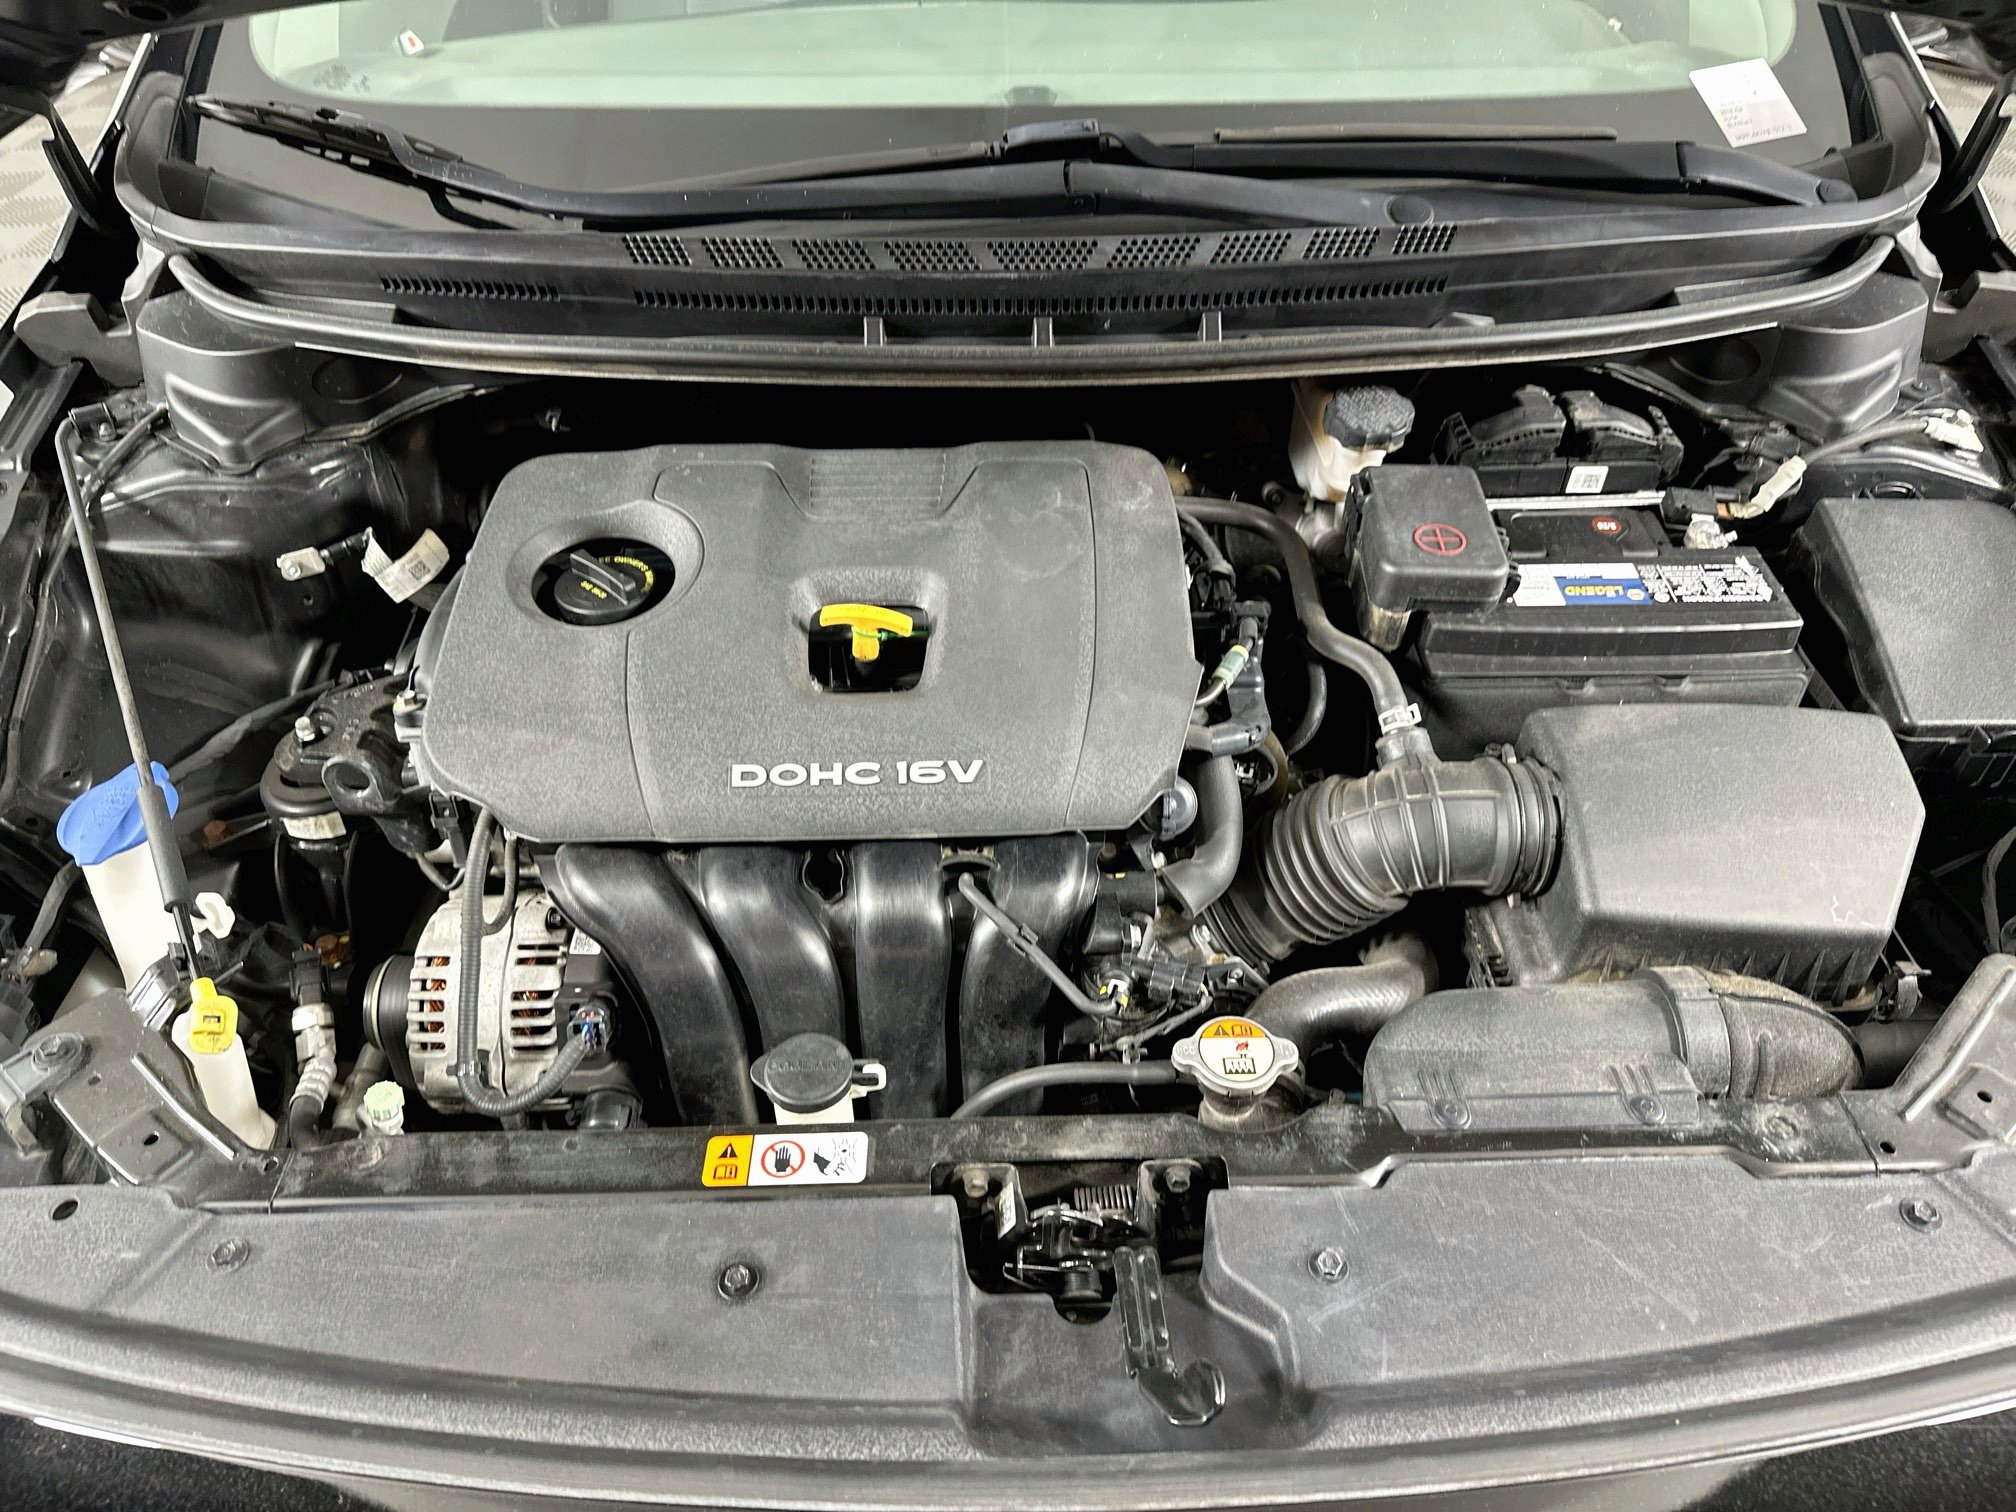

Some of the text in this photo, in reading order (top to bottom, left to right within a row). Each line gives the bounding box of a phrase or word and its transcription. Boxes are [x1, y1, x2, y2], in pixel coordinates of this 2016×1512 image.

[1565, 585, 1624, 596] LEGEND
[731, 759, 984, 788] DOHC 16V
